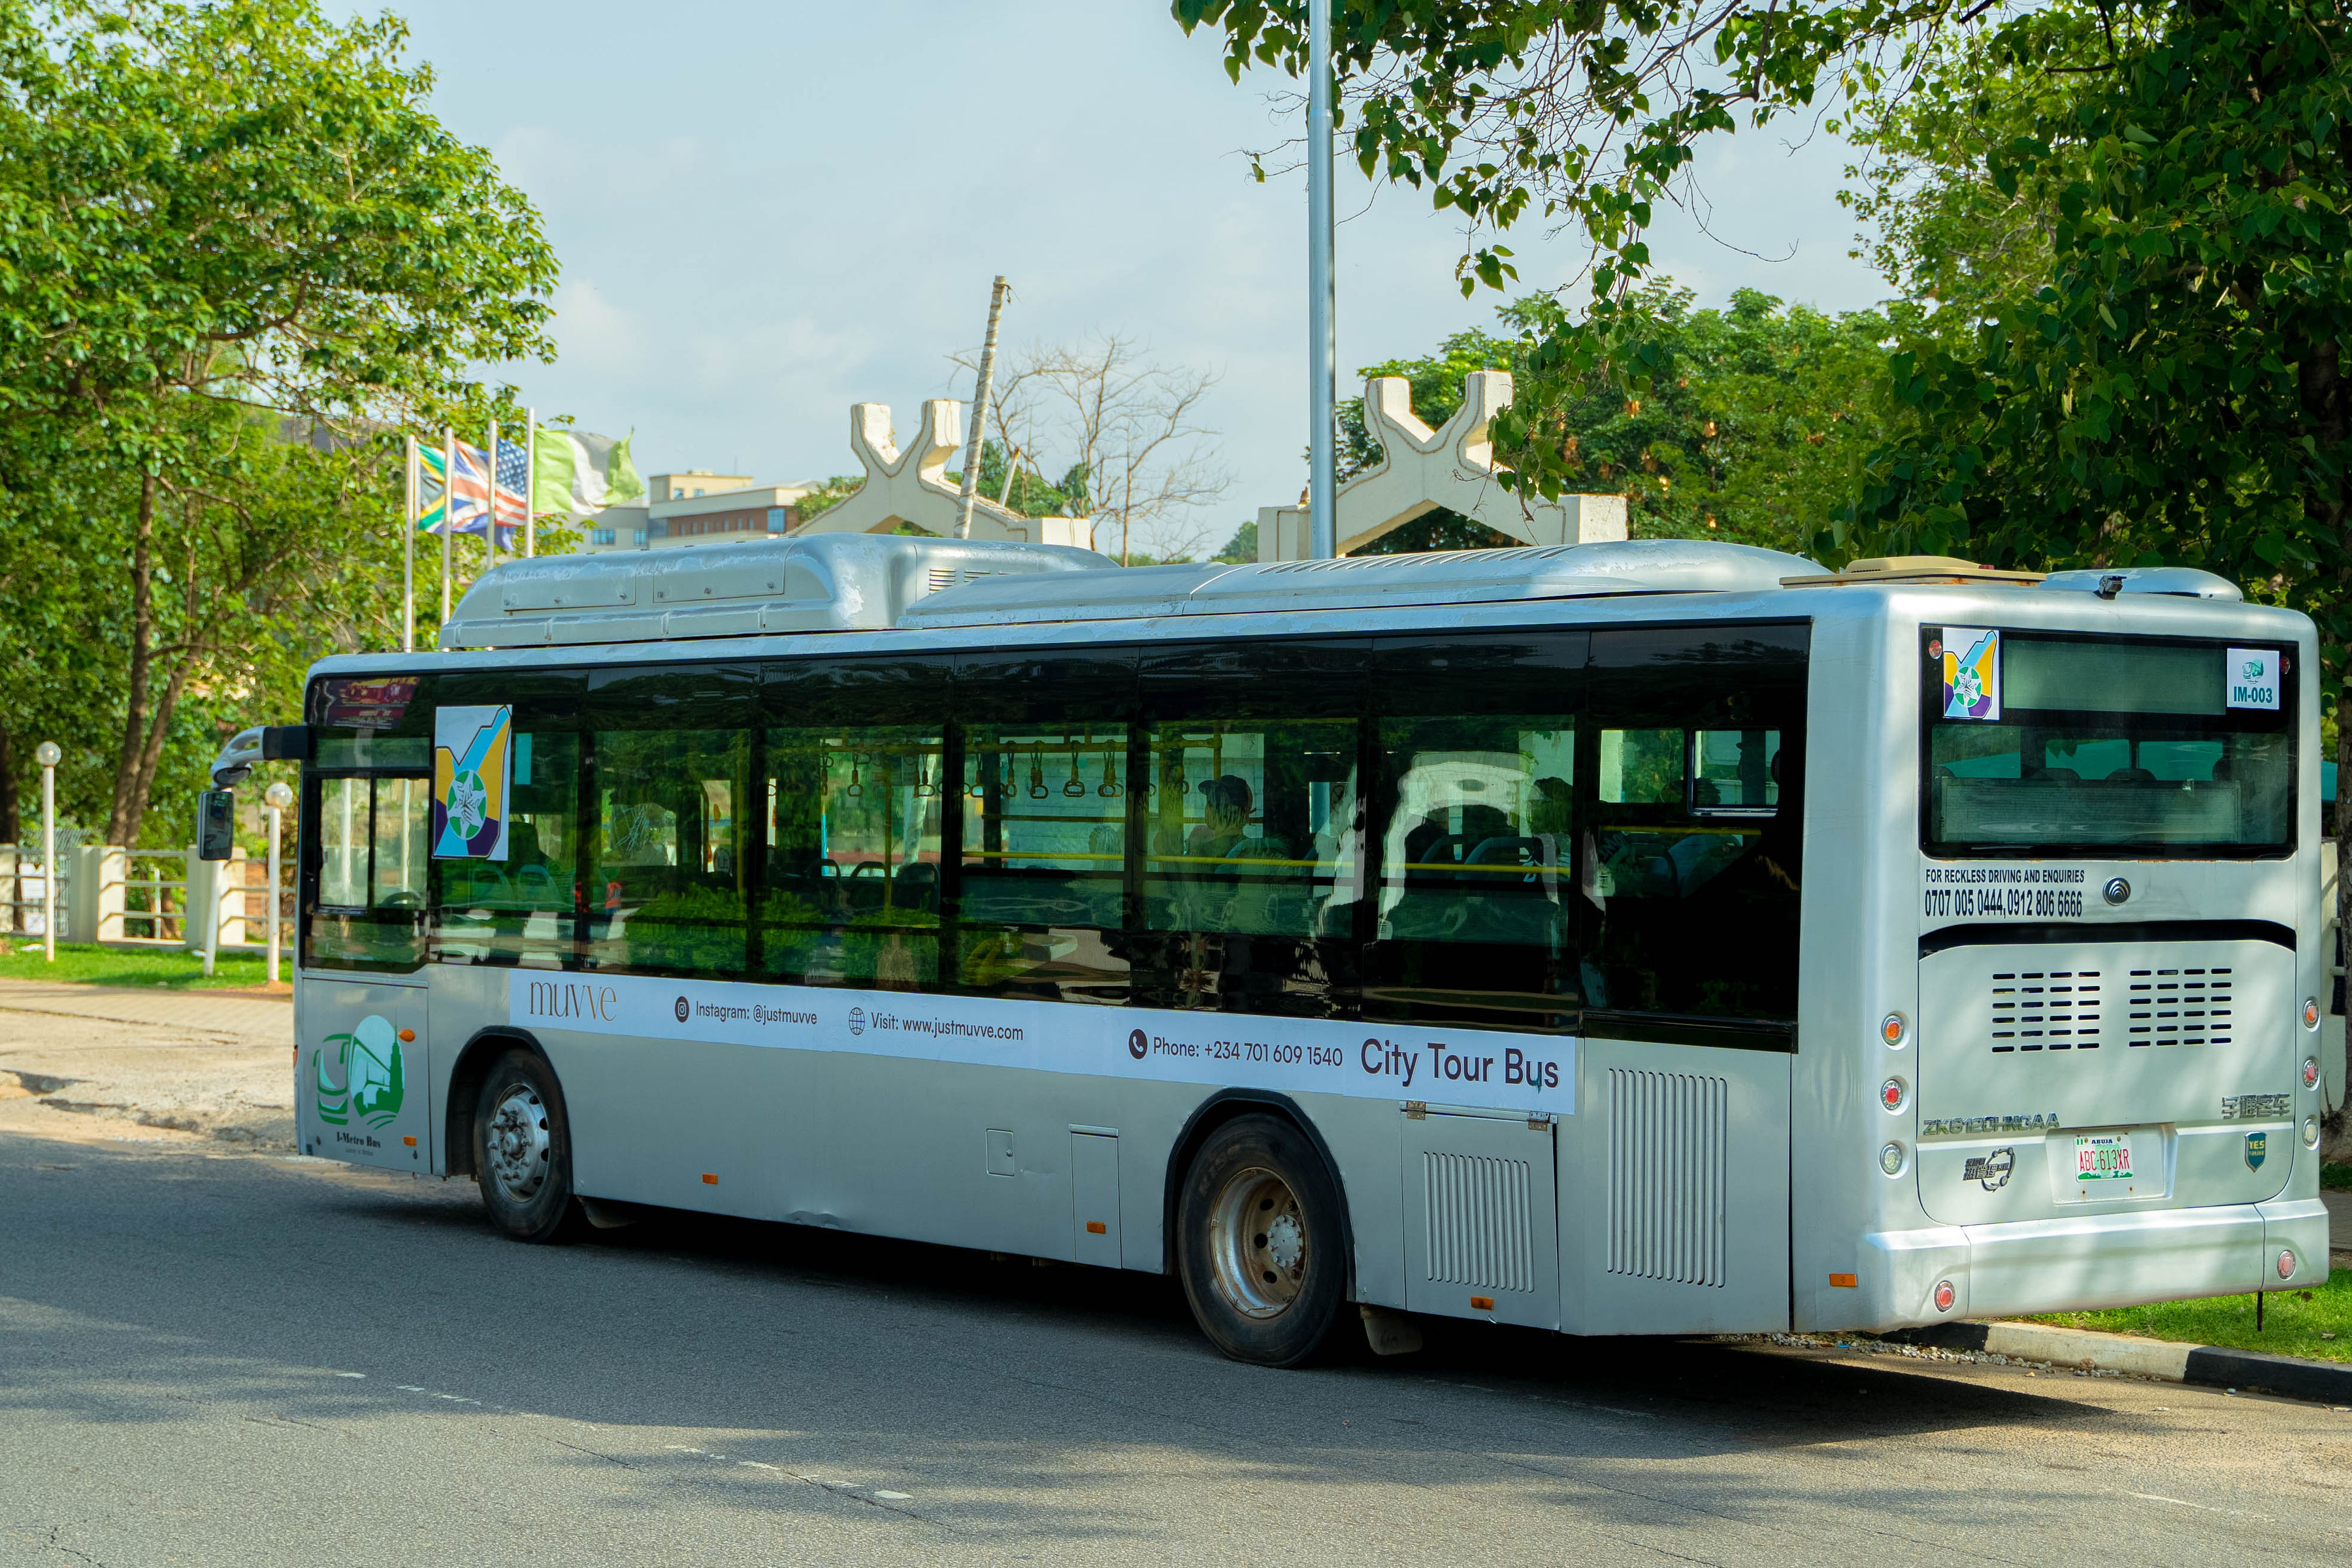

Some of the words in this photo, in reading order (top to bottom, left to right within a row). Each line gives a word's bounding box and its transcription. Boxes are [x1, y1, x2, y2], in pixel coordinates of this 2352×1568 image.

[2233, 686, 2273, 704] IM-003
[1926, 869, 1942, 883] FOR
[1944, 868, 1986, 883] RECKLESS
[1988, 869, 2021, 883] DRIVING
[2023, 869, 2040, 883] AND
[2042, 869, 2085, 884] ENQUIRIES
[1925, 889, 1952, 917] 0707
[1955, 889, 1974, 917] 005
[2036, 889, 2055, 917] 806
[2057, 890, 2083, 918] 6666
[529, 981, 617, 1022] muvve
[695, 1000, 750, 1022] Instagram:
[753, 1004, 818, 1026] @justmuvve
[871, 1011, 899, 1030] Visit:
[902, 1017, 1024, 1041] www.justmuvve.com
[1153, 1036, 1200, 1058] Phone:
[1204, 1040, 1241, 1060] +234
[1245, 1043, 1269, 1062] 701
[1273, 1044, 1303, 1064] 609
[1307, 1046, 1343, 1067] 1540
[1361, 1037, 1418, 1087] City
[1427, 1042, 1494, 1083] Tour
[1505, 1047, 1560, 1089] Bus
[366, 1135, 381, 1148] Bus
[2249, 1141, 2264, 1149] YES
